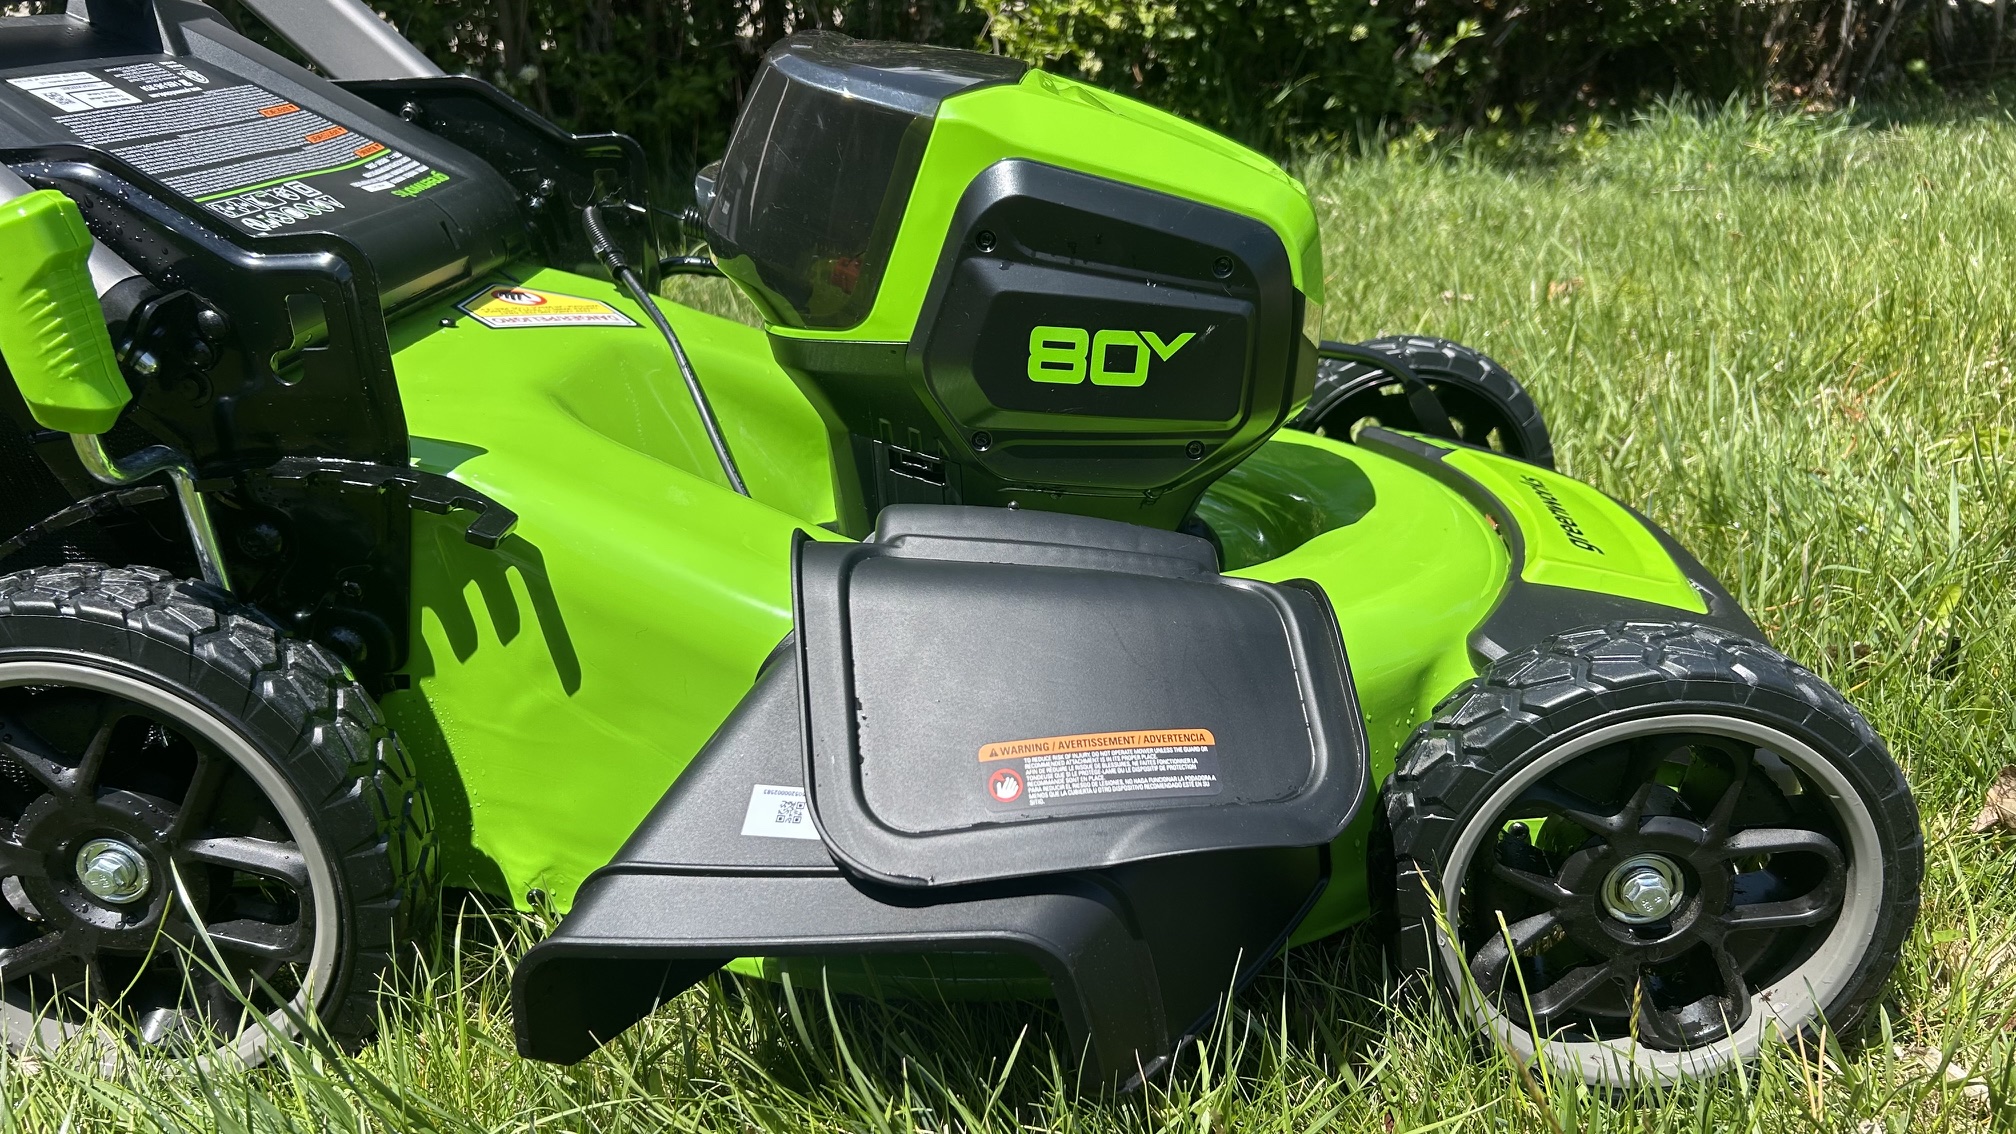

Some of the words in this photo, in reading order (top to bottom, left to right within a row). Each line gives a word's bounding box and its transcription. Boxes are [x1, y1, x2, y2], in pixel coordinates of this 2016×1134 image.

[1518, 474, 1606, 556] greenworks
[999, 742, 1050, 757] WARNING
[1058, 735, 1136, 750] AVERTISSEMENT
[1143, 733, 1206, 744] ADVERTENCIA
